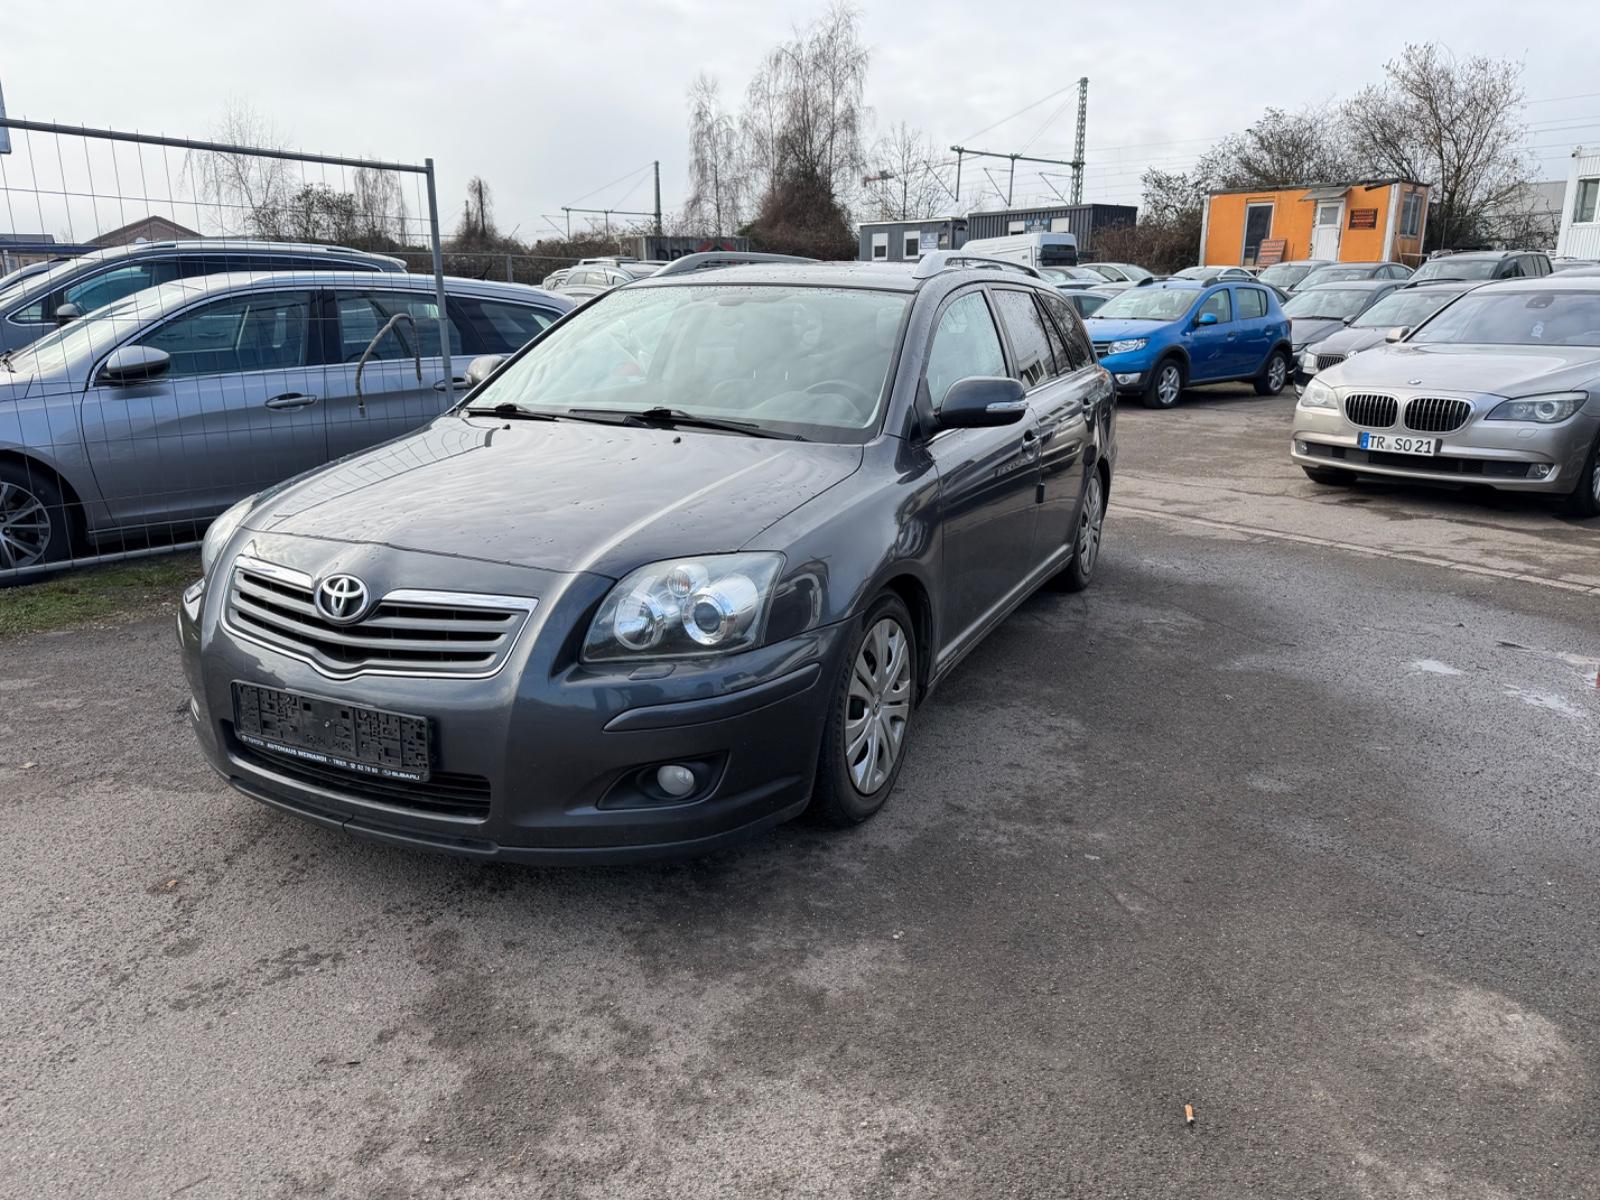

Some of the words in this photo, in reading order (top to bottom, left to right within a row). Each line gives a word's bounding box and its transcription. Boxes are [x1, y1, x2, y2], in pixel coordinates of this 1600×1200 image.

[1370, 435, 1385, 449] TR
[1394, 437, 1412, 451] SO
[1414, 440, 1432, 453] 21
[267, 743, 297, 755] AUTOHAUS
[391, 771, 420, 780] SUBARU
